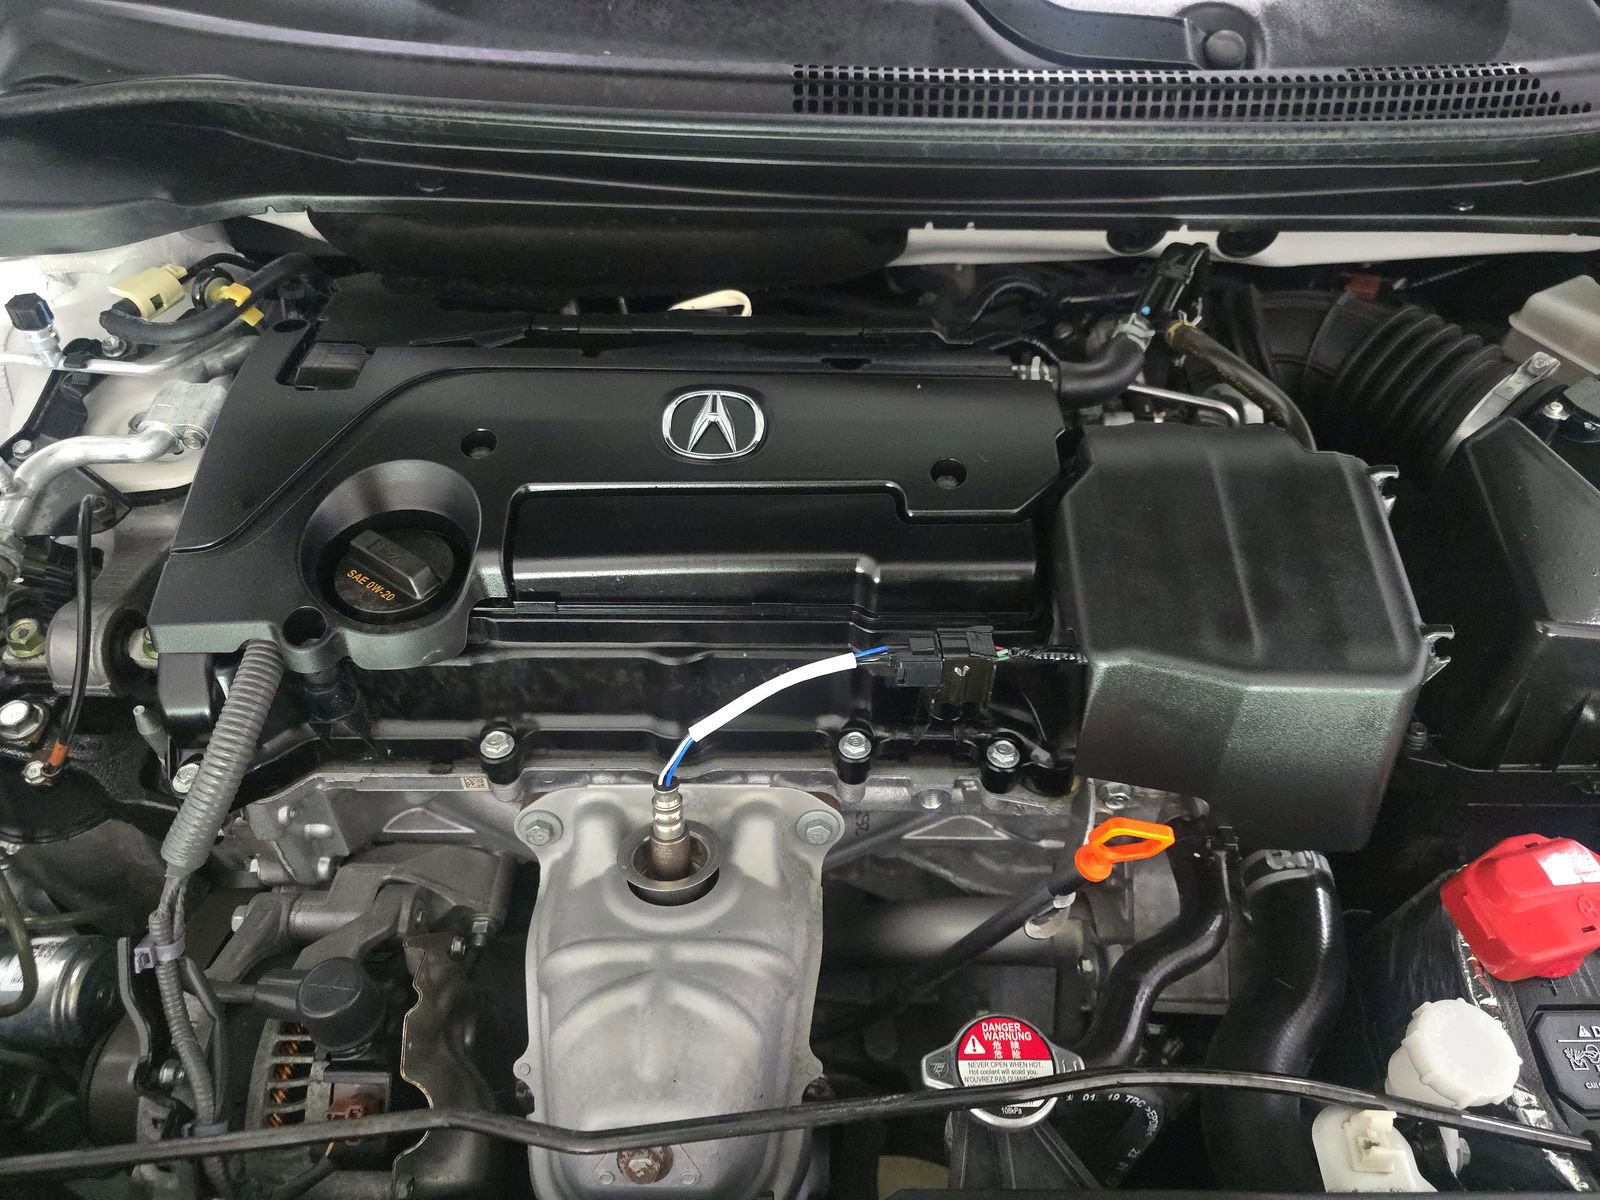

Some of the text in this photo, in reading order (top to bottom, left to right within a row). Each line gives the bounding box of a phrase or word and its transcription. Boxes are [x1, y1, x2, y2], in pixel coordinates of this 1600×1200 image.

[346, 569, 396, 601] SAE 0W-20
[981, 1022, 1021, 1032] DANGER
[983, 1031, 1032, 1041] WARNUNG
[1082, 1093, 1096, 1101] 01
[1107, 1093, 1120, 1101] 19
[1124, 1094, 1146, 1108] TPC
